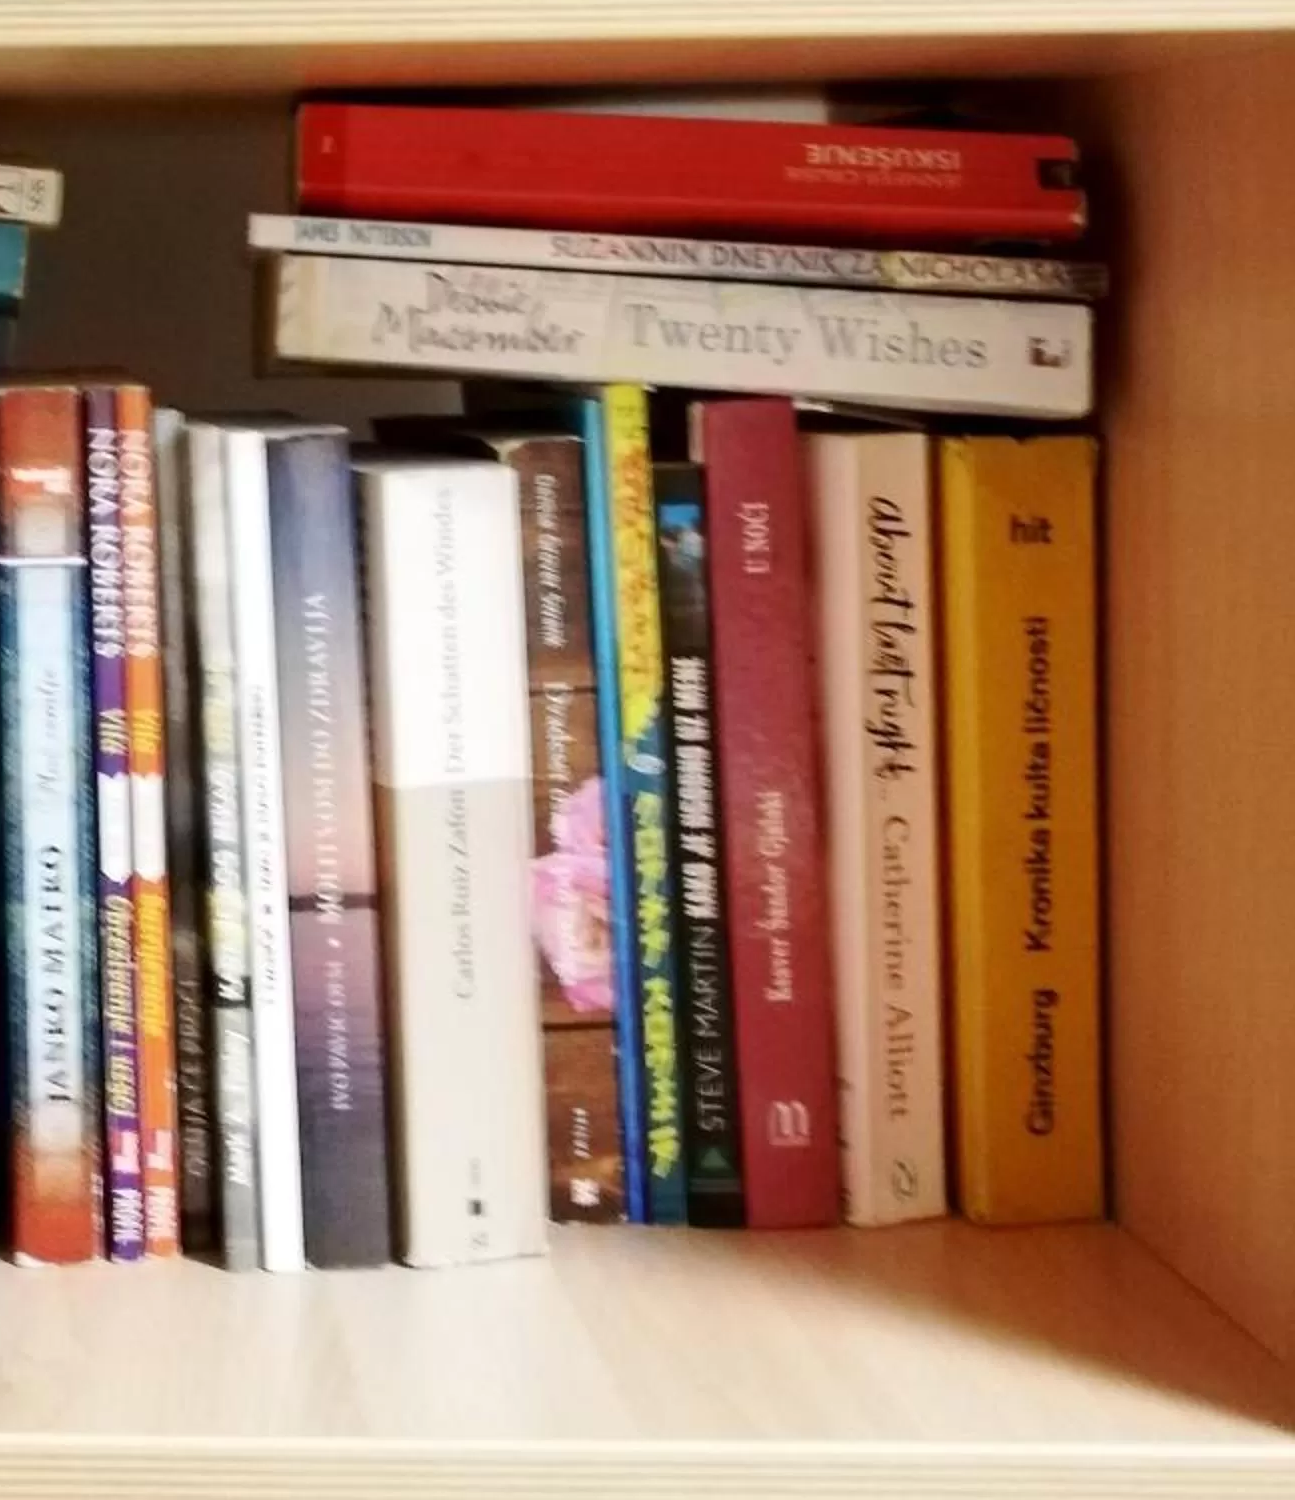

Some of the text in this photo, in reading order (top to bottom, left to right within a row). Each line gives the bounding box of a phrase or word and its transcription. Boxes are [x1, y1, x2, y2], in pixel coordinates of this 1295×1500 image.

[293, 219, 340, 243] JAMES
[548, 234, 1072, 288] SUZANNIN DNEVNIK ZA NICHOLASA
[621, 302, 803, 366] Twenty
[818, 314, 989, 370] Wishes
[87, 427, 125, 658] NORA ROBERTS
[119, 428, 159, 659] NORA ROBERTS
[743, 560, 771, 574] U
[867, 495, 916, 609] about
[1010, 514, 1055, 546] hit
[431, 485, 467, 774] Der Schatten des Windes
[869, 620, 917, 703] last
[678, 831, 718, 858] JE
[681, 860, 720, 920] KAKO
[1022, 615, 1061, 1137] Ginzburg Kronika kulta ličnosti
[450, 866, 476, 1000] Carlos Ruiz
[881, 814, 913, 993] Catherine
[37, 844, 72, 1103] JANKO MATKO
[688, 924, 721, 1041] MARTIN
[694, 1049, 726, 1132] STEVE
[883, 1003, 915, 1120] Alliott
